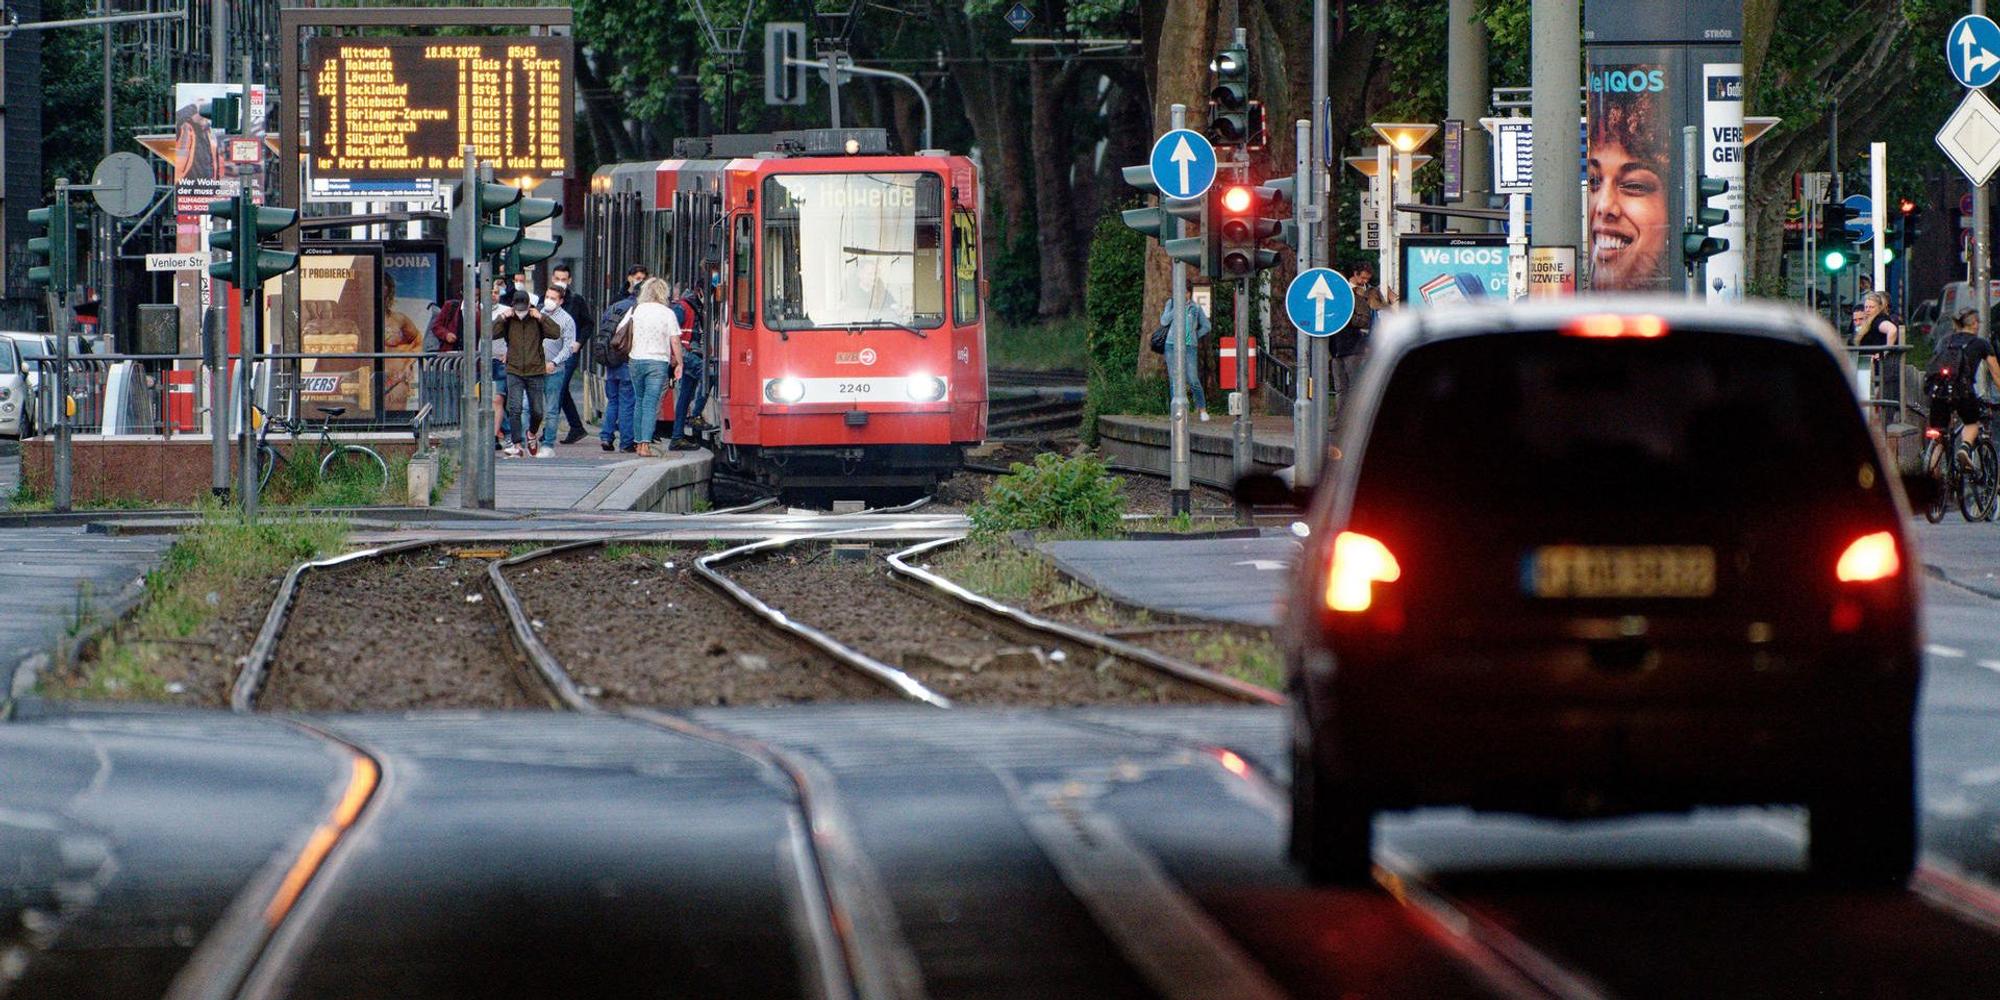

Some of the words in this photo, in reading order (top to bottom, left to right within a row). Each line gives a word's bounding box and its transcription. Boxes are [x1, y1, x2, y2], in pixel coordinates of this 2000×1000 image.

[341, 47, 390, 58] Mittwoch
[425, 46, 480, 58] 18.05.2022
[508, 46, 536, 58] 05:45
[324, 60, 337, 70] 13
[346, 60, 393, 70] Holweide
[472, 59, 500, 70] Gleis
[506, 59, 512, 70] 4
[522, 59, 560, 70] Sofort
[318, 72, 337, 82] 143
[346, 72, 394, 82] Lövenich
[472, 71, 500, 84] Bstg.
[506, 71, 512, 82] A
[529, 71, 536, 82] 2
[541, 71, 559, 82] Min
[1604, 70, 1665, 92] IQOS
[318, 84, 337, 95] 143
[346, 84, 407, 95] Bocklemünd
[472, 84, 500, 96] Bstg.
[506, 84, 512, 94] B
[529, 84, 536, 94] 3
[541, 84, 559, 94] Min
[330, 96, 337, 107] 4
[346, 96, 406, 107] Schlebusch
[472, 96, 500, 106] Gleis
[506, 96, 512, 106] 1
[529, 96, 536, 106] 4
[541, 96, 559, 106] Min
[330, 108, 337, 120] 3
[346, 108, 448, 120] Görlinger-Zentrum
[472, 108, 500, 119] Gleis
[506, 108, 512, 119] 2
[529, 108, 536, 119] 4
[541, 108, 559, 119] Min
[330, 121, 337, 132] 3
[346, 121, 417, 132] Thielenbruch
[472, 121, 500, 132] Gleis
[506, 121, 512, 132] 1
[529, 121, 536, 132] 6
[541, 121, 559, 132] Min
[324, 133, 337, 144] 13
[346, 133, 404, 145] Sülzgürtel
[472, 133, 500, 144] Gleis
[506, 133, 512, 144] 3
[529, 133, 536, 144] 7
[541, 133, 559, 144] Min
[330, 145, 337, 156] 4
[346, 145, 407, 156] Bocklemünd
[506, 145, 512, 156] 2
[529, 145, 536, 156] 9
[541, 145, 559, 156] Min
[339, 157, 364, 168] Porz
[370, 156, 423, 168] erinnern?
[428, 157, 442, 168] Um
[508, 157, 536, 168] viele
[820, 182, 914, 207] Holweide
[152, 258, 186, 268] Venloer
[190, 257, 206, 267] Str.
[1420, 250, 1450, 264] We
[1455, 249, 1502, 264] IQOS
[840, 384, 870, 393] 2240
